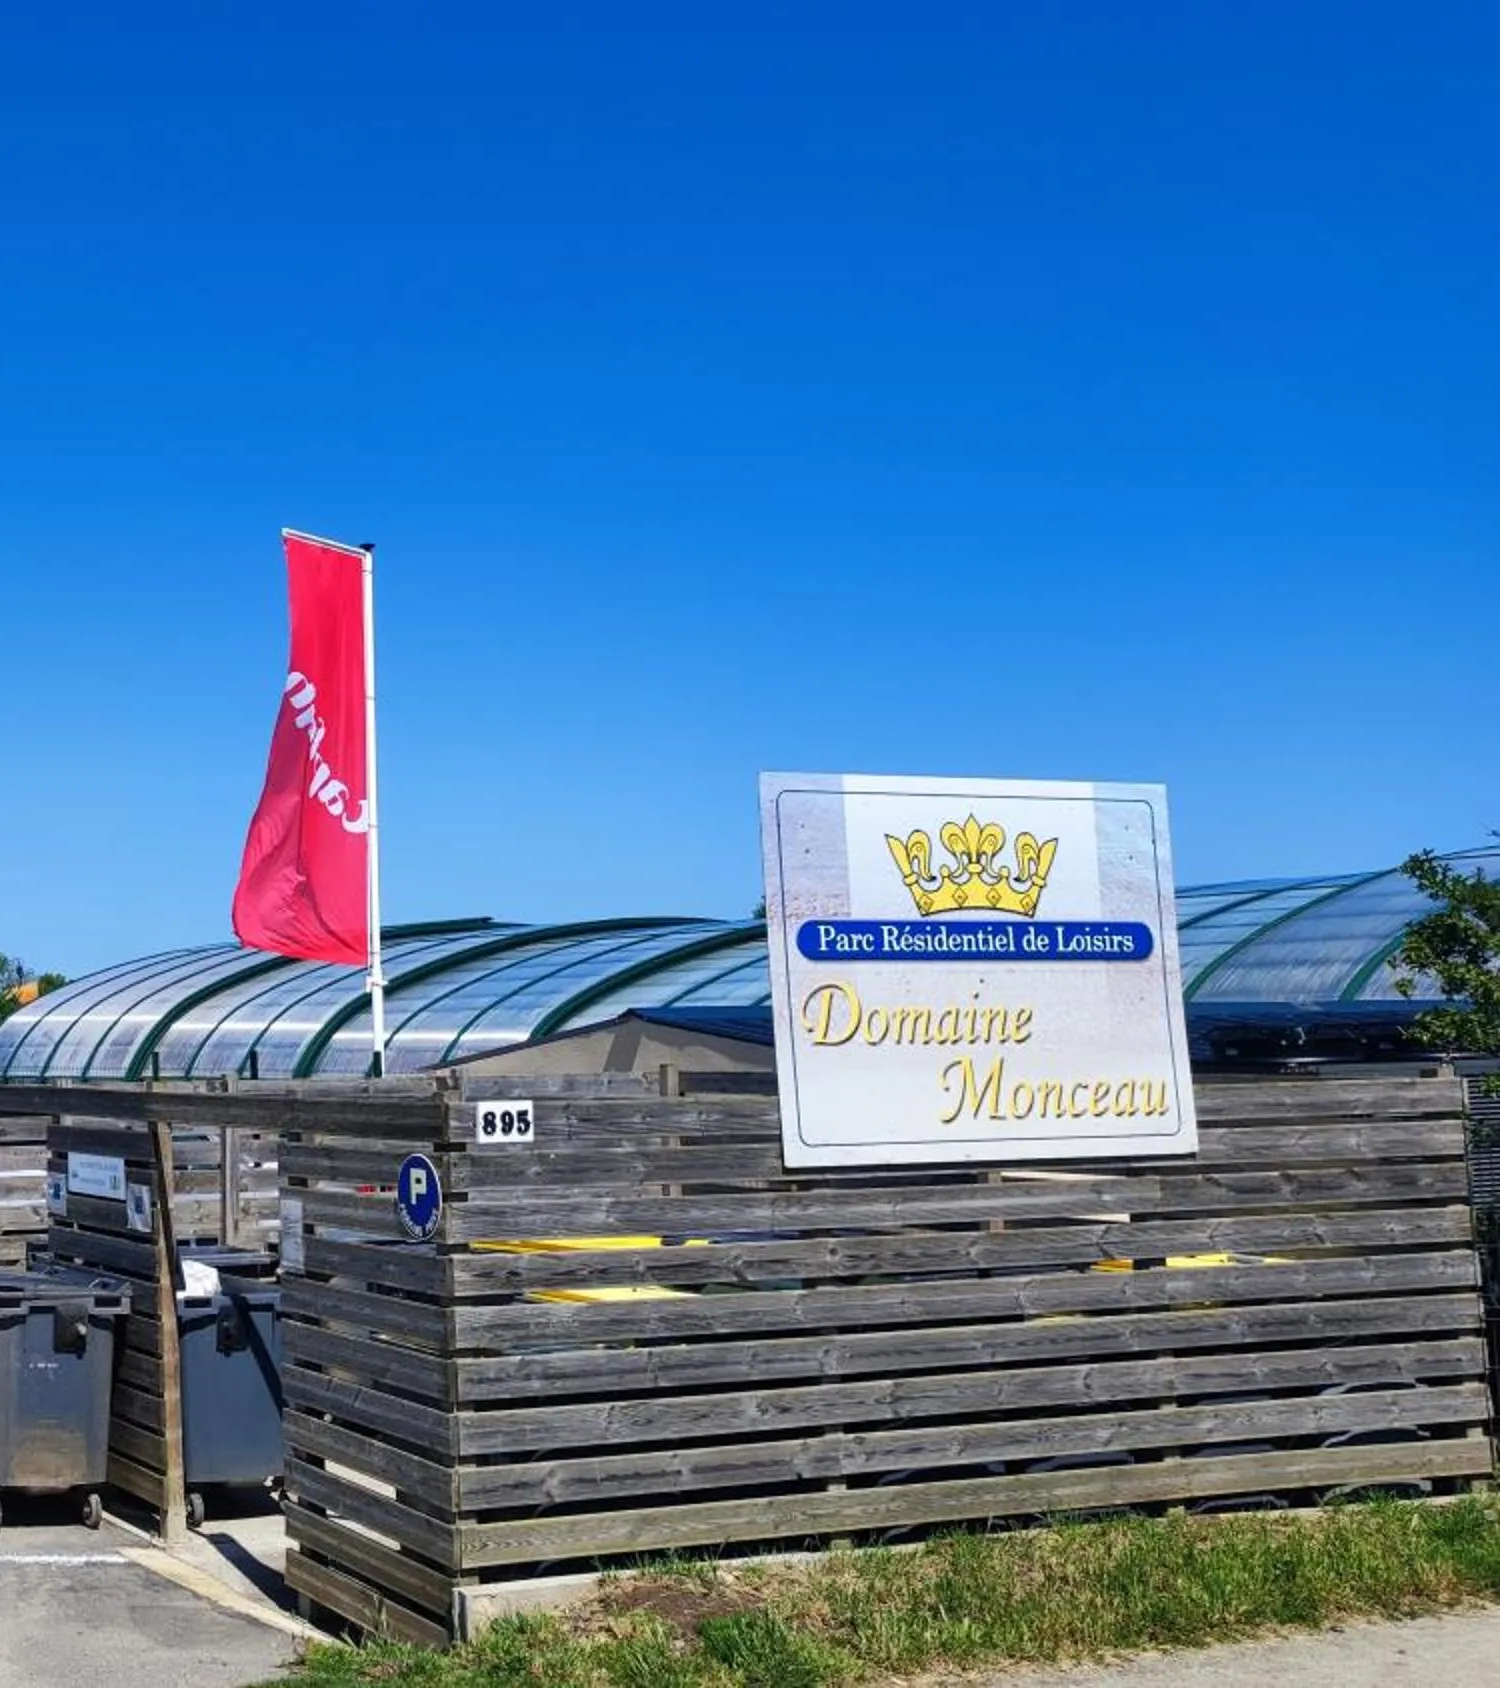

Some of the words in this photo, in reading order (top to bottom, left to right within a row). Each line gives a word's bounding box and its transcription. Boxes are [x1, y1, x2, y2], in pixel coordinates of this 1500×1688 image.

[817, 925, 874, 952] Parc
[881, 925, 1015, 952] Résidentiel
[1023, 927, 1049, 952] de
[1056, 928, 1134, 953] Loisirs
[802, 982, 1034, 1047] Domaine
[939, 1056, 1170, 1123] Monceau
[482, 1109, 531, 1137] 895
[409, 1167, 427, 1205] P
